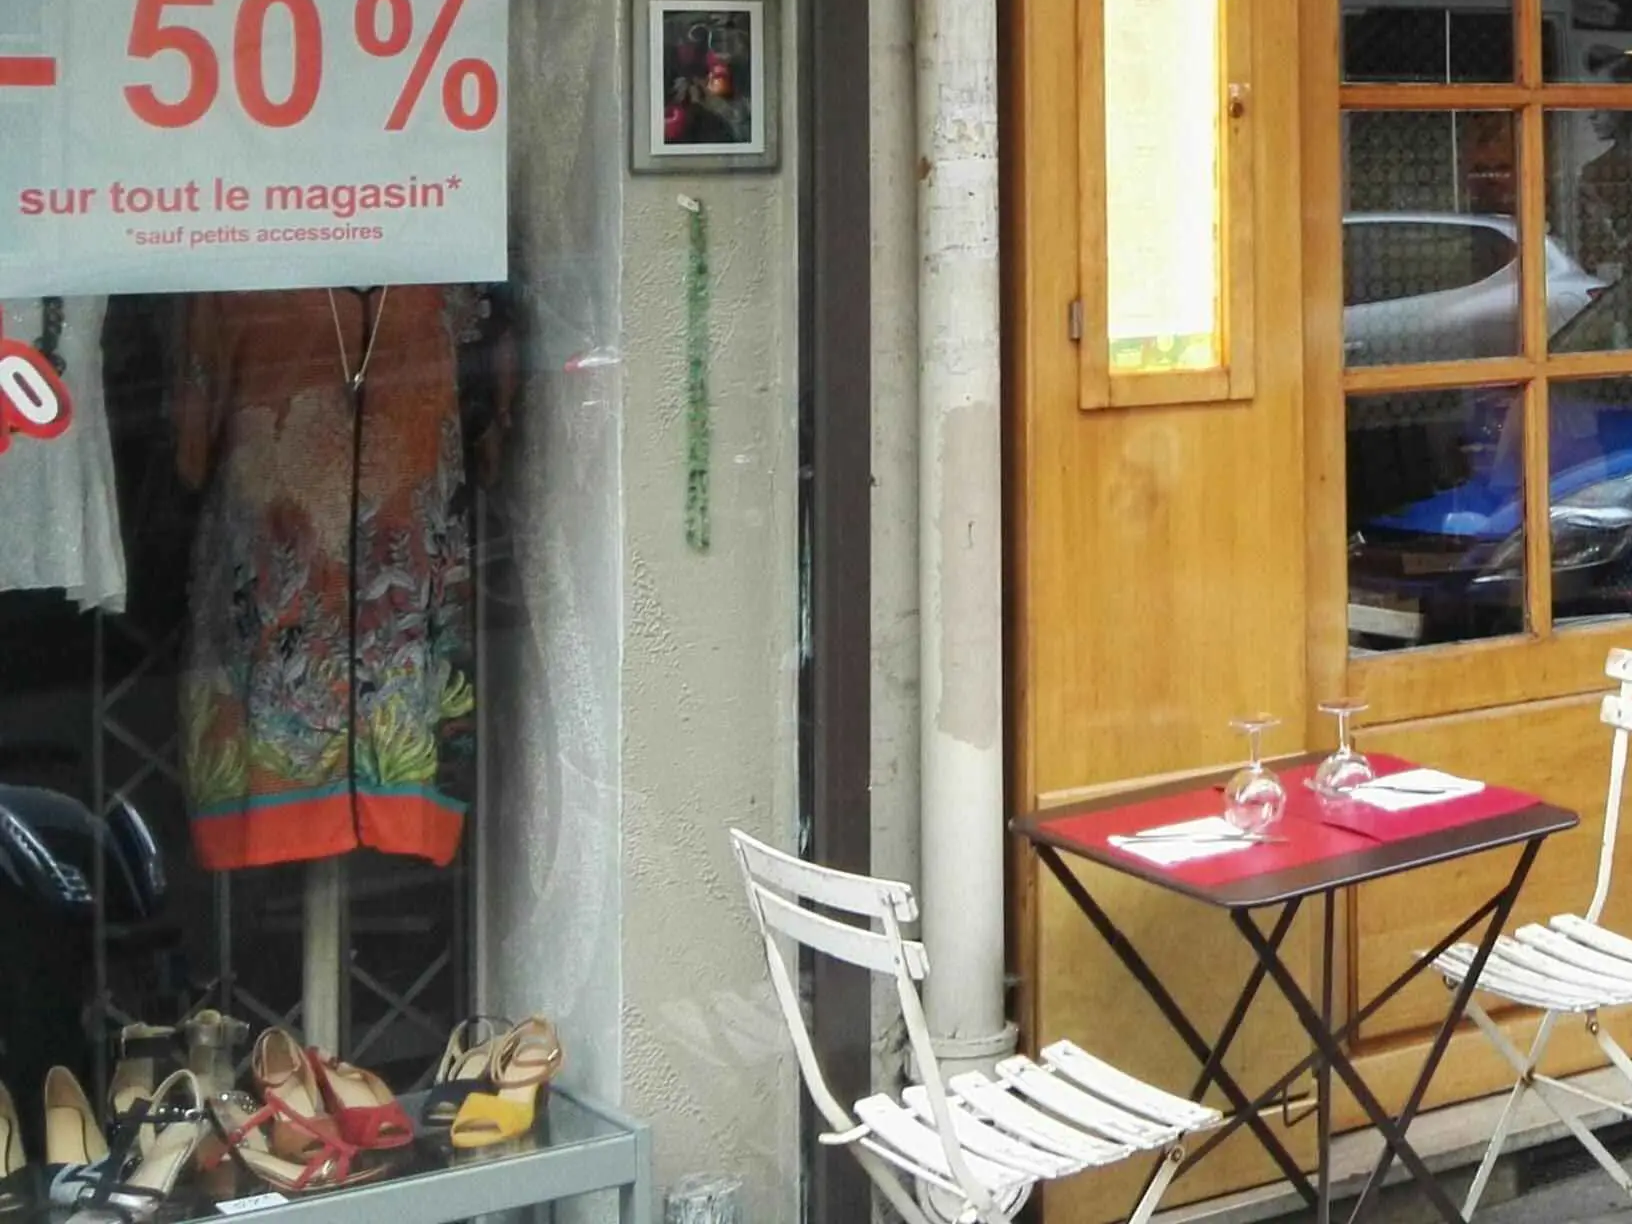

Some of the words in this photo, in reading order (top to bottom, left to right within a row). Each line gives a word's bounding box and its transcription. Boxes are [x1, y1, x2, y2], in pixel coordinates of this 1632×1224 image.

[19, 186, 97, 216] sur
[109, 180, 199, 215] tout
[213, 176, 250, 212] le
[190, 223, 250, 249] petits
[256, 222, 384, 244] accessoires
